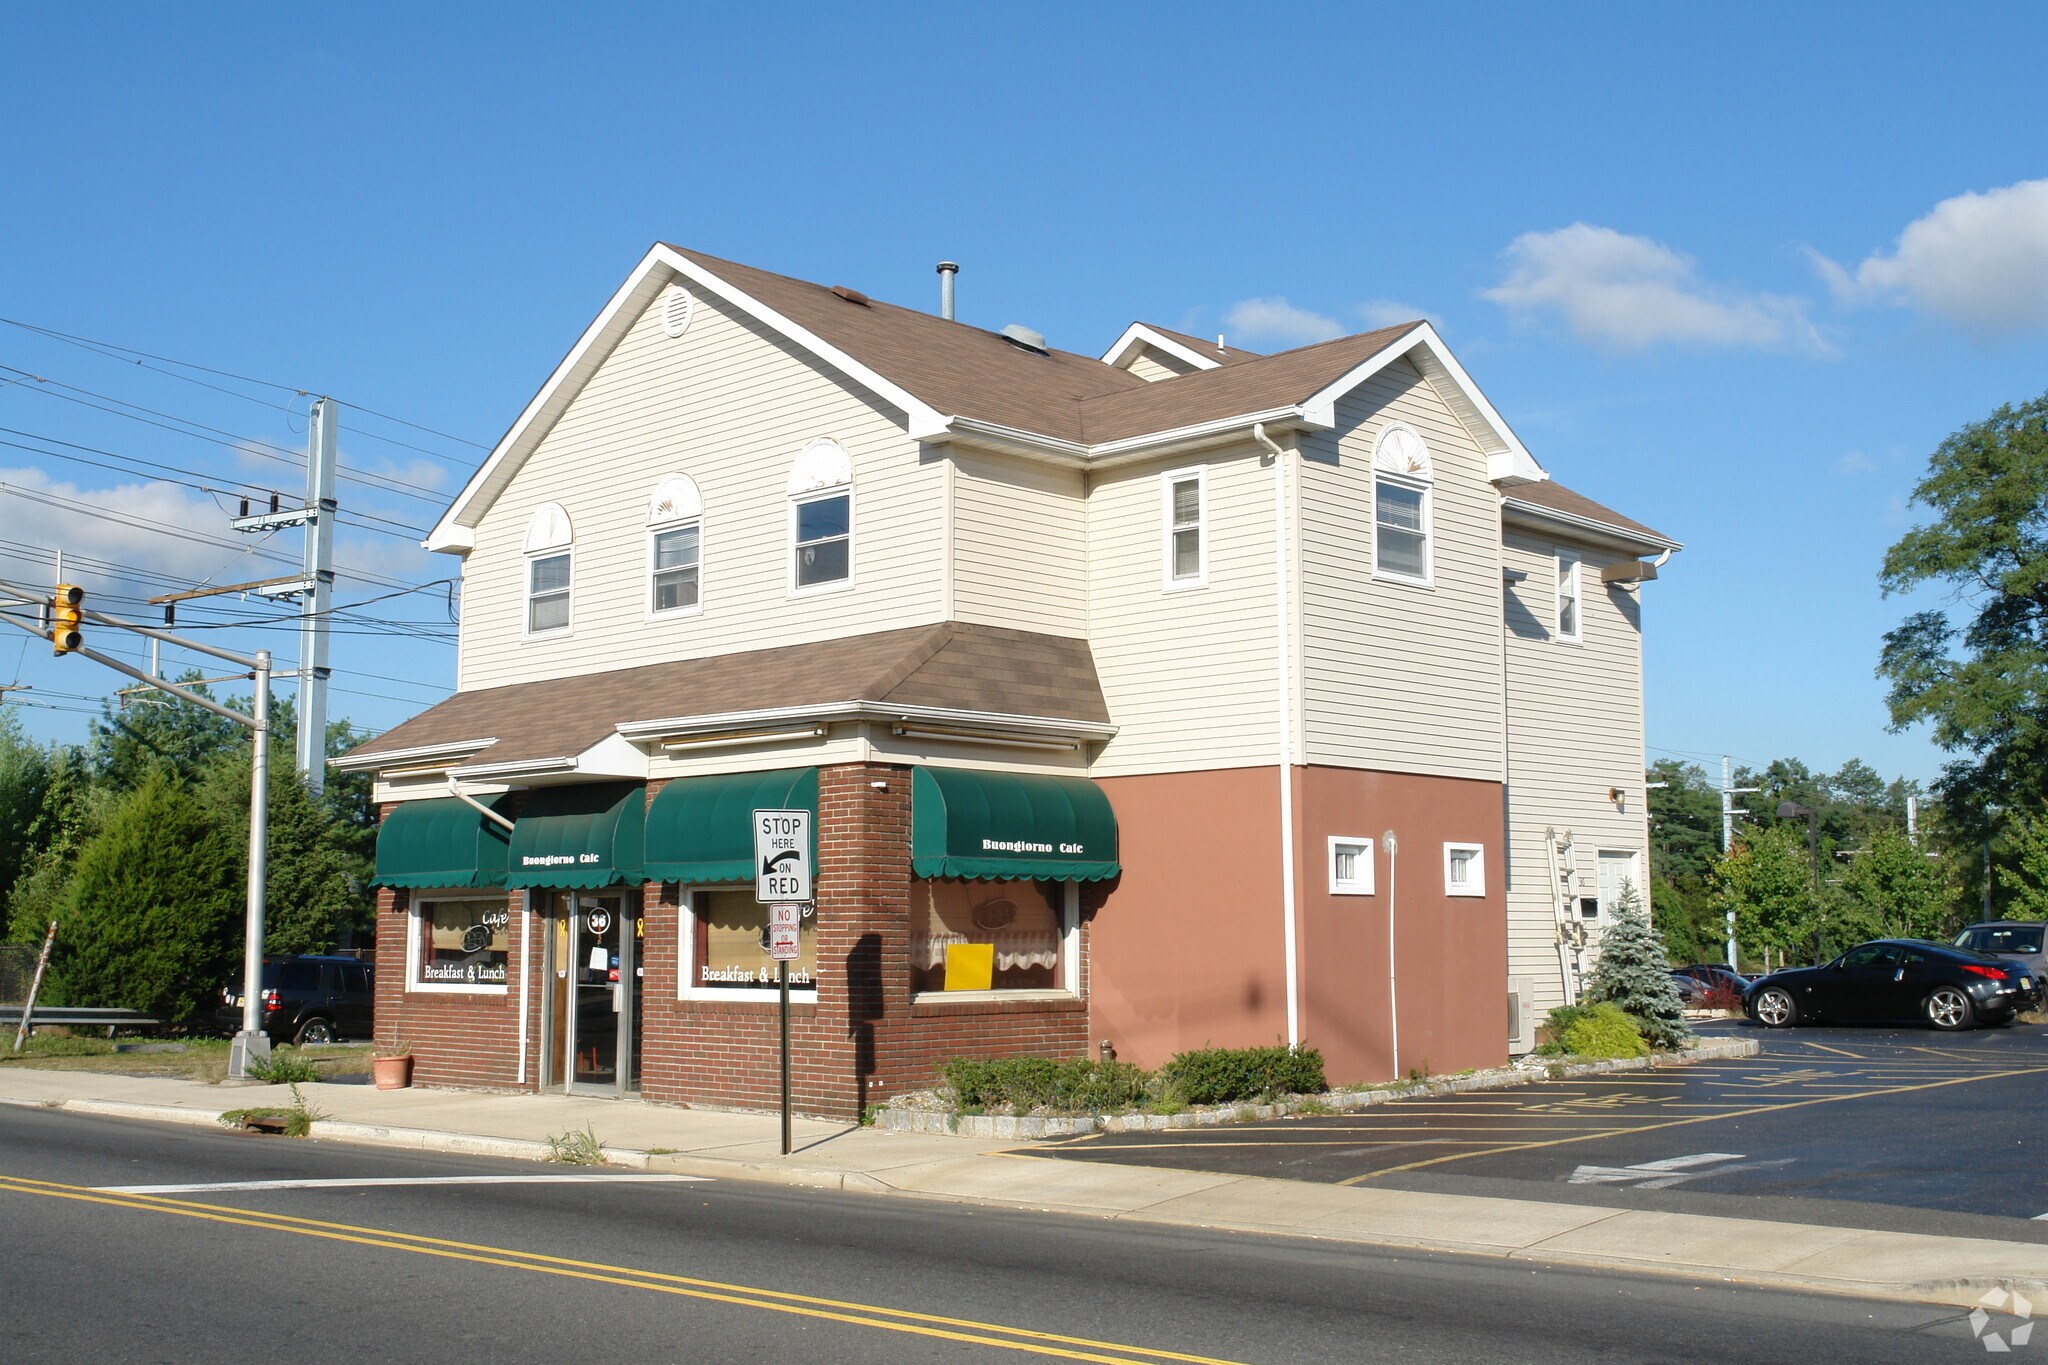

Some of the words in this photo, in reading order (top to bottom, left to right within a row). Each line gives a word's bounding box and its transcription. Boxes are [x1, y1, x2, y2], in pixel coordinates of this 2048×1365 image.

[762, 818, 801, 835] STOP
[771, 838, 795, 849] HERE
[982, 839, 1053, 853] Buongiorno
[522, 855, 575, 866] Buongiorno
[779, 863, 791, 874] ON
[769, 877, 799, 894] RED
[591, 914, 607, 928] 36
[778, 910, 791, 921] NO
[773, 923, 797, 933] STOPPING
[781, 934, 789, 943] OR
[773, 945, 798, 955] STANDING
[425, 963, 464, 979] Breakfast
[467, 965, 475, 981] &
[478, 964, 505, 979] Lunch
[701, 965, 754, 982] Breakfast
[759, 967, 769, 983] &
[773, 966, 810, 984] Lnch
